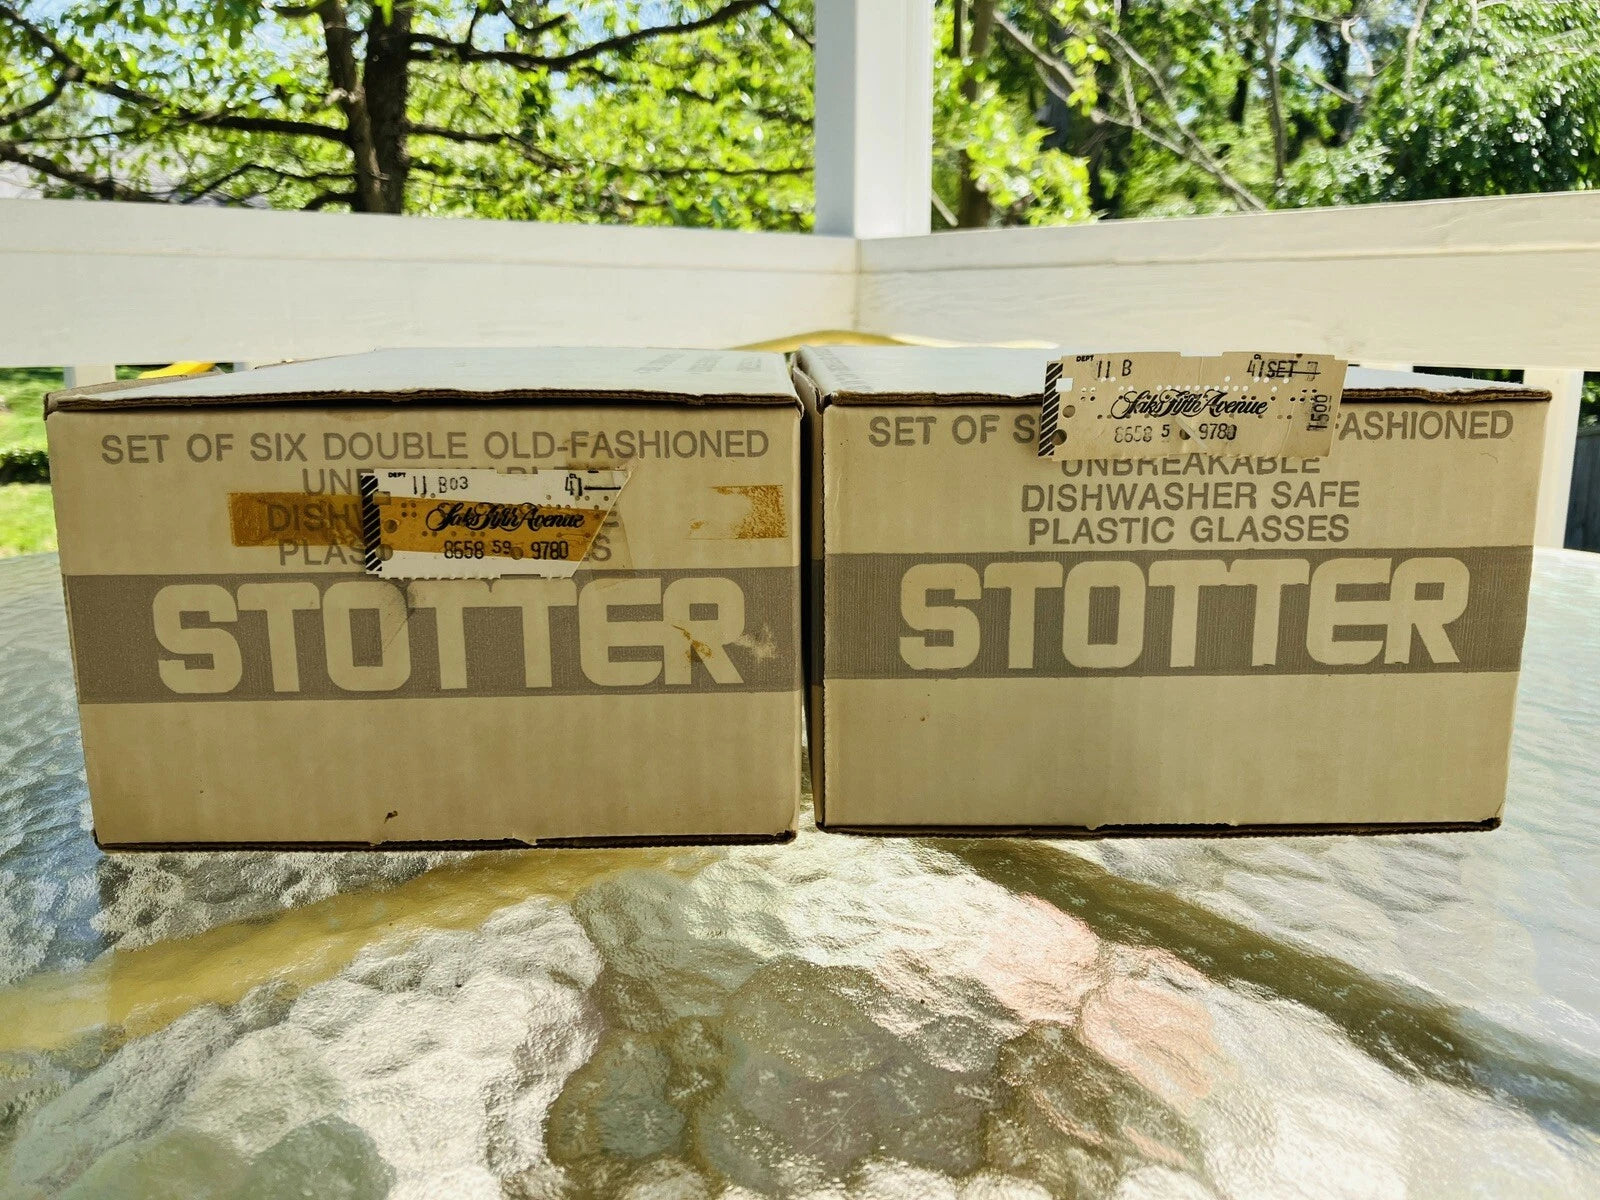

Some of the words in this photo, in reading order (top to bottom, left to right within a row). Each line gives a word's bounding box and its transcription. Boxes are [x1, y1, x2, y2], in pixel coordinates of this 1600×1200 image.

[1076, 354, 1094, 362] DEPT
[1122, 359, 1132, 376] B
[1111, 390, 1164, 419] Saks
[1158, 389, 1203, 418] Fifth
[1184, 389, 1268, 418] Avenue
[868, 416, 937, 447] SET
[952, 414, 1000, 445] OF
[1335, 409, 1514, 441] ASHIONED
[1198, 422, 1238, 441] 9780
[101, 434, 170, 465] SET
[186, 433, 234, 462] OF
[250, 432, 308, 462] SIX
[323, 430, 468, 461] DOUBLE
[484, 429, 770, 460] OLD-FASHIONED
[1021, 482, 1257, 513] DISHWASHER
[1271, 480, 1361, 509] SAFE
[426, 502, 478, 532] Saks
[501, 502, 585, 532] Avenue
[1028, 516, 1176, 546] PLASTIC
[1190, 513, 1350, 543] GLASSES
[278, 537, 368, 566] PLAS
[443, 540, 485, 560] 8658
[531, 541, 569, 561] 9780
[900, 557, 1471, 670] STOTTER
[152, 577, 746, 694] STOTTER
